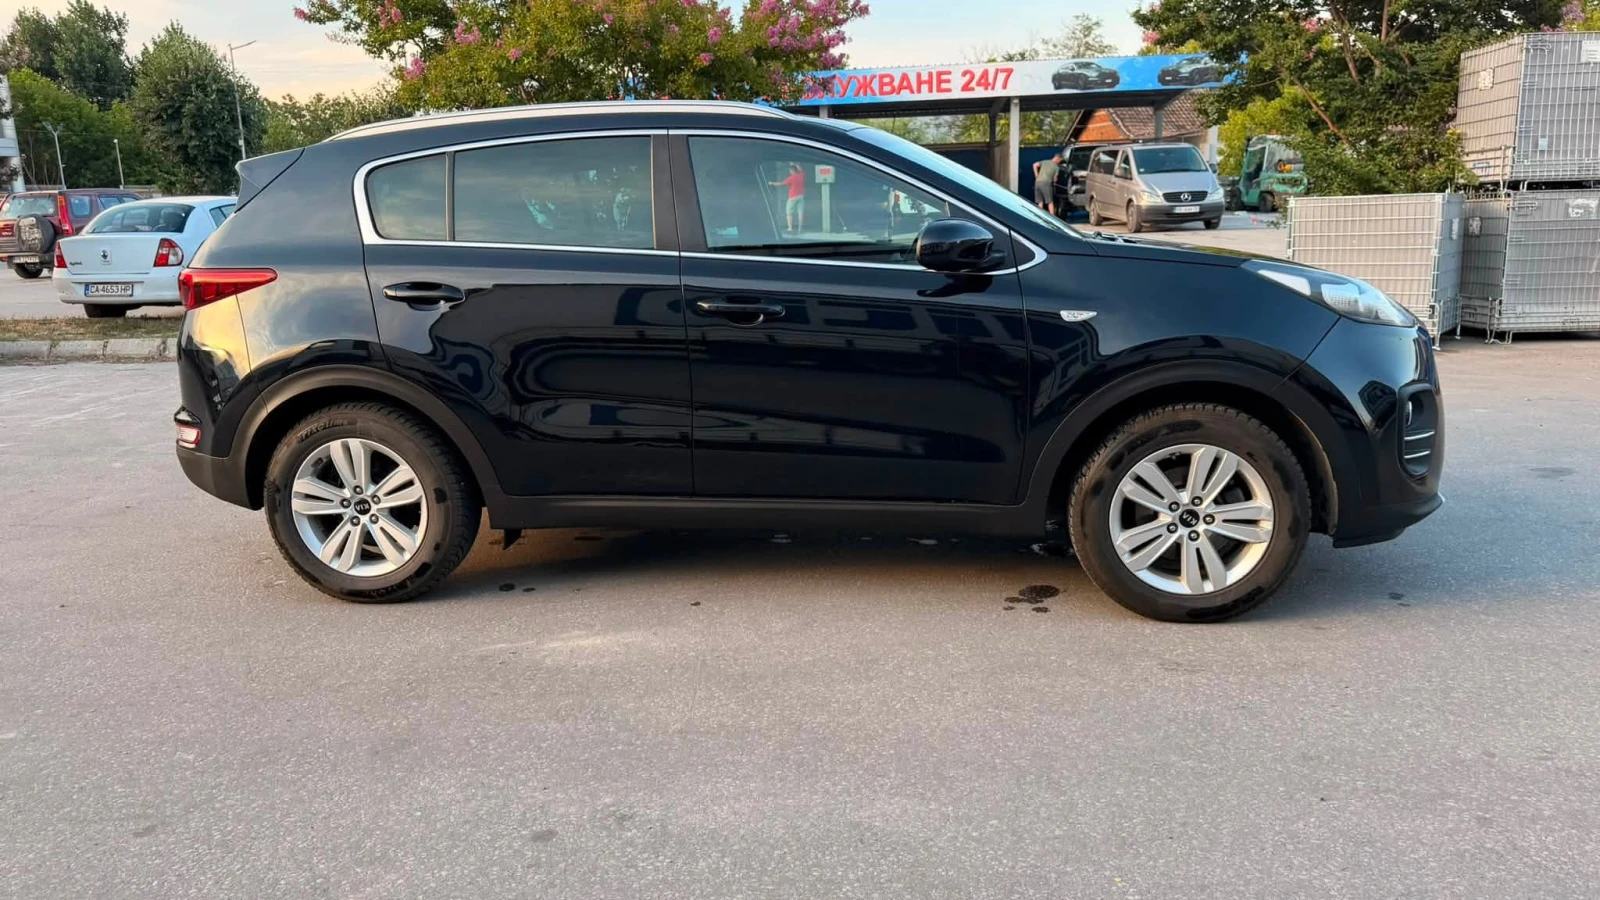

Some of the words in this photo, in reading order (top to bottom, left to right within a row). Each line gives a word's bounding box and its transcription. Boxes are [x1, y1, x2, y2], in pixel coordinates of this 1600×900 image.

[960, 68, 1014, 91] 24/7
[101, 285, 119, 294] 4653
[355, 502, 370, 511] KIA
[1182, 511, 1198, 526] KIA
